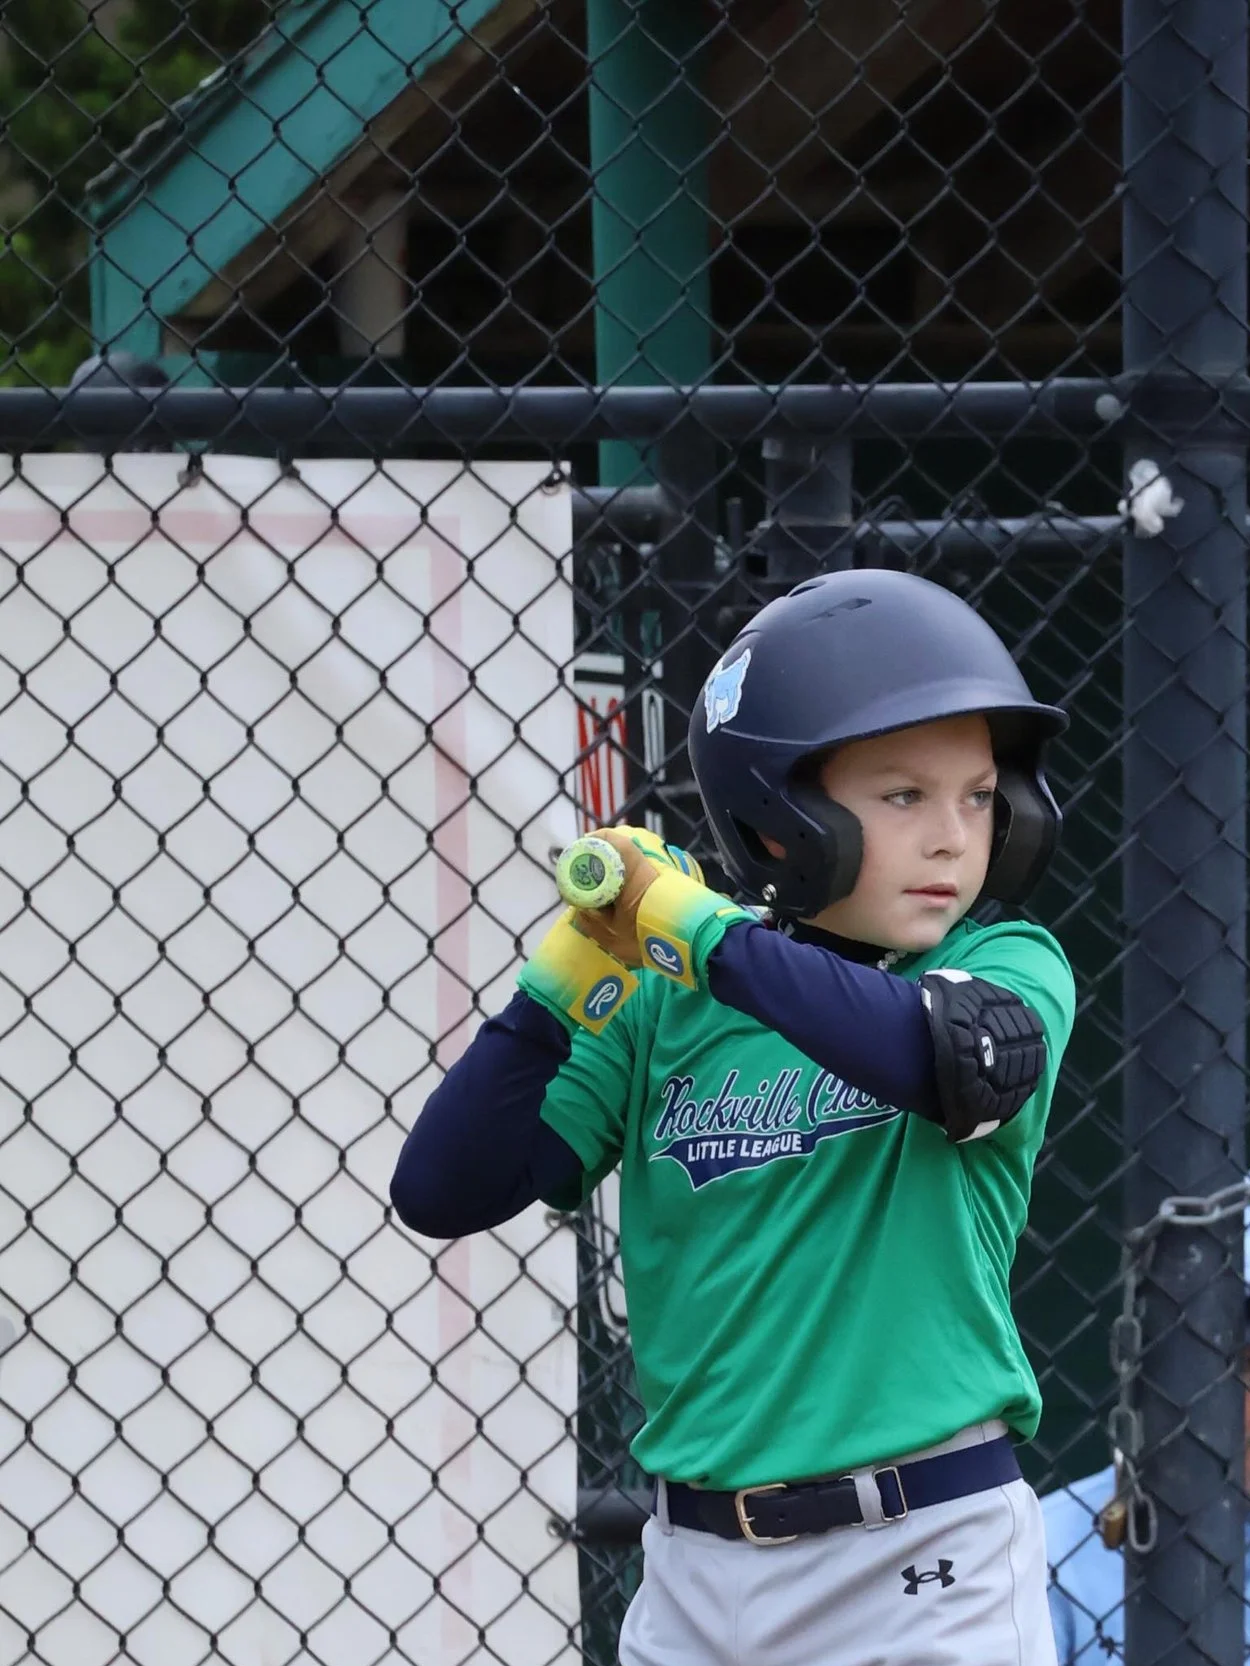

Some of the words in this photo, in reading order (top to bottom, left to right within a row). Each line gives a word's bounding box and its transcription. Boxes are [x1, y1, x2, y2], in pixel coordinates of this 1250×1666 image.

[654, 1068, 801, 1140] Rockville
[687, 1138, 736, 1163] LITTLE
[740, 1133, 802, 1158] LEAGUE
